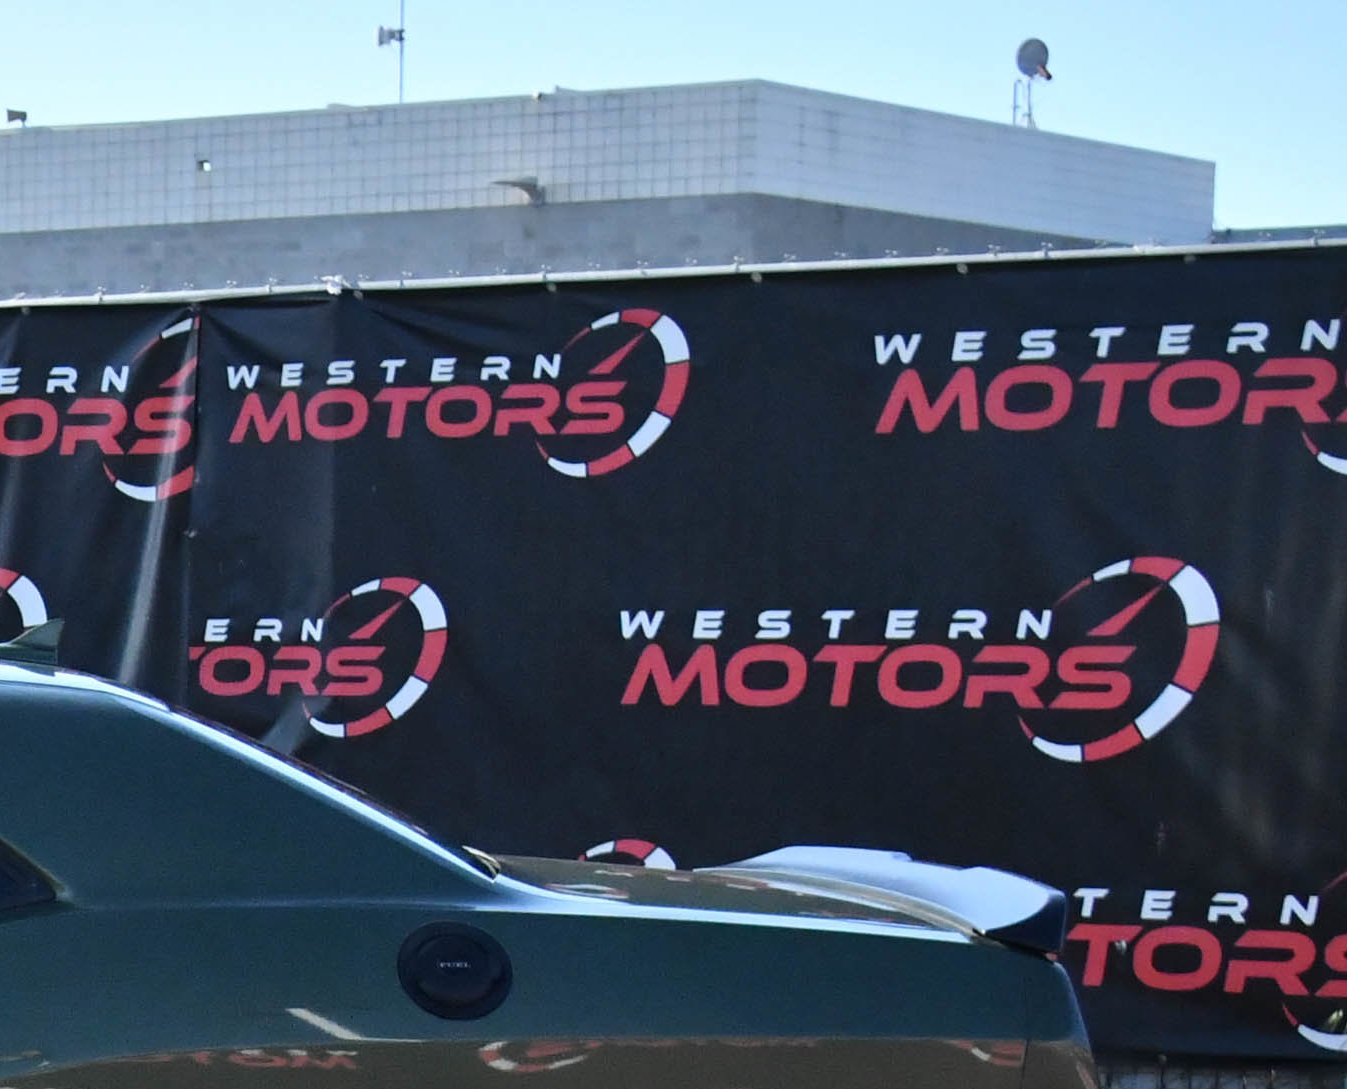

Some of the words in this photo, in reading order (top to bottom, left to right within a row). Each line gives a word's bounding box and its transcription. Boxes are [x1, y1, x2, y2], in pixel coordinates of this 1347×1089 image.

[874, 318, 1341, 366] WESTERN
[226, 353, 562, 390] WESTERN
[874, 357, 1347, 435] MOTOR
[228, 380, 627, 444] MOTORS
[619, 608, 1053, 640] WESTERN
[189, 646, 386, 697] ORS
[620, 643, 1137, 710] MOTORS
